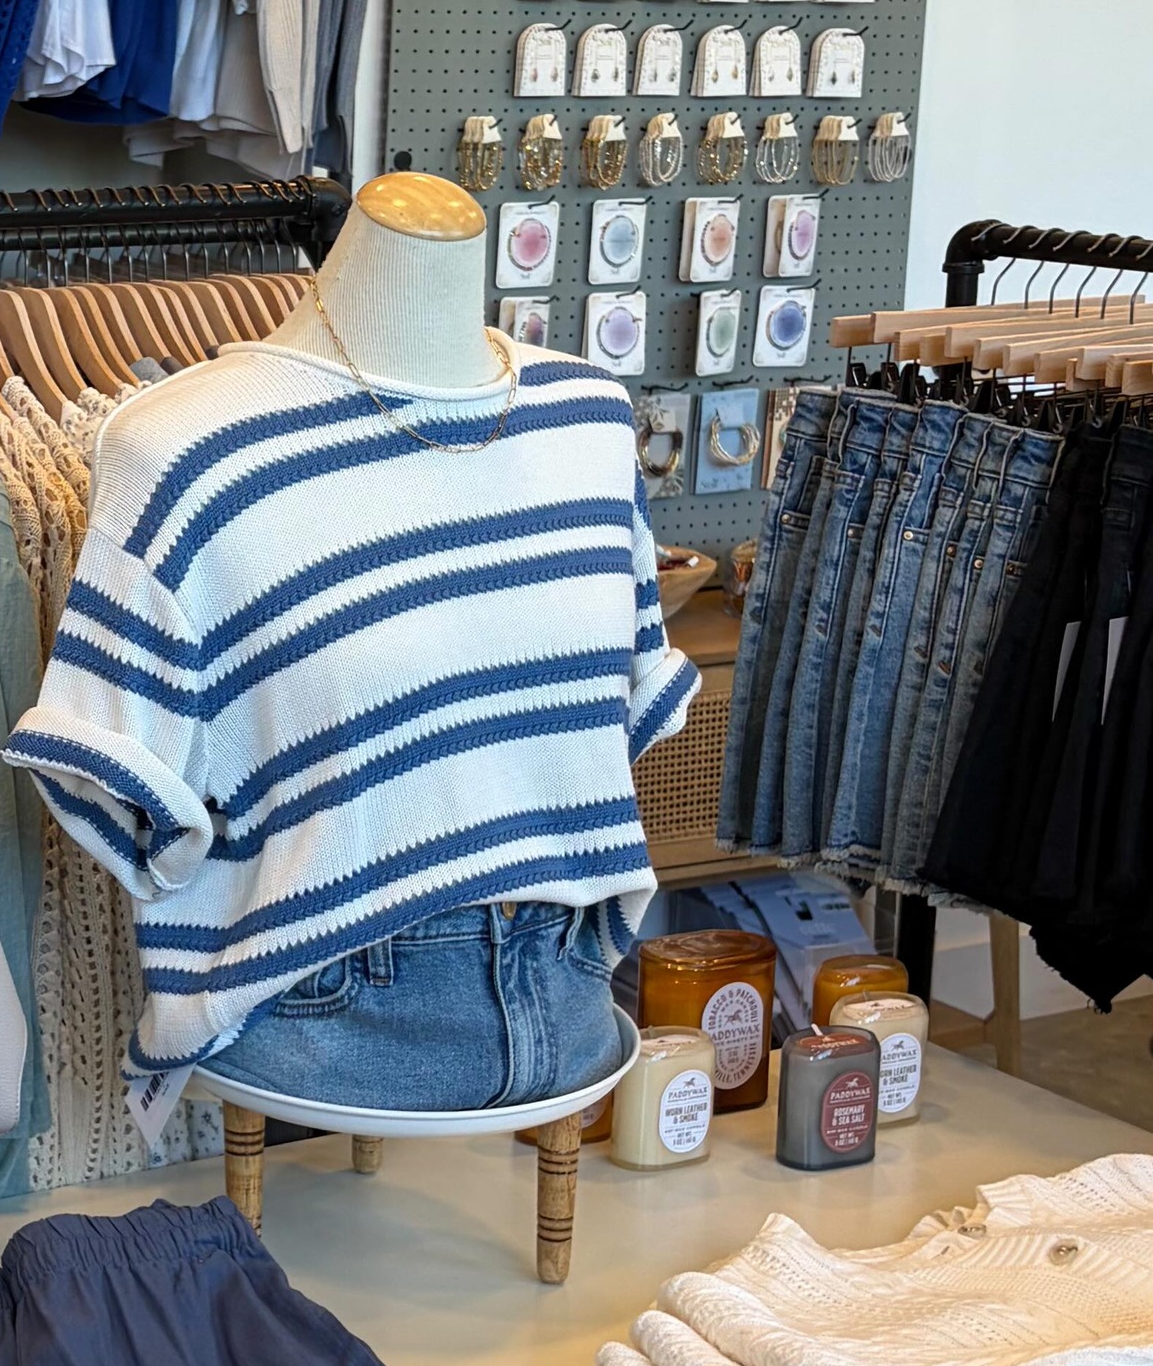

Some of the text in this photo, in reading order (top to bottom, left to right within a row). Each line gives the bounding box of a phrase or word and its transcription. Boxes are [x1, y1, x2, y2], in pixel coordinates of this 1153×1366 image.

[708, 994, 727, 1031] TOBACCO
[735, 988, 758, 1023] PATCHOULI
[711, 1023, 761, 1042] ADDYWAX
[881, 1049, 917, 1062] ADDYWAX
[893, 1064, 917, 1077] LEATHER
[889, 1074, 908, 1085] SMOKE
[668, 1086, 708, 1100] PADDYWAX
[830, 1087, 871, 1100] PADDYWAX
[683, 1102, 708, 1114] LEATHER
[834, 1104, 865, 1117] ROSEMARY
[679, 1112, 698, 1124] SMOKE
[838, 1115, 850, 1125] SEA
[850, 1113, 865, 1124] SALT
